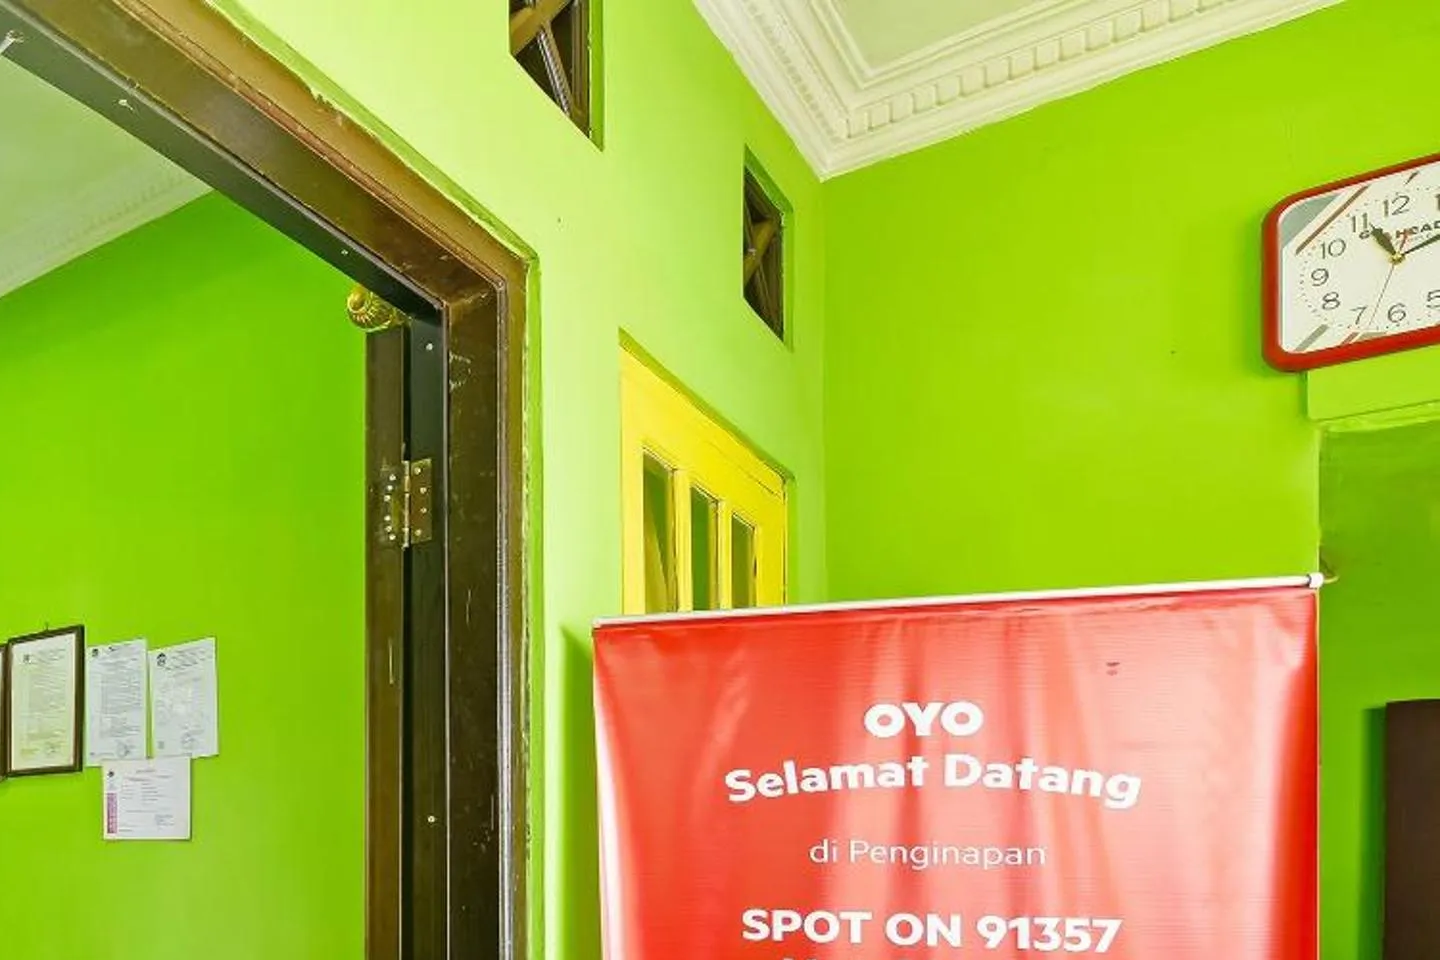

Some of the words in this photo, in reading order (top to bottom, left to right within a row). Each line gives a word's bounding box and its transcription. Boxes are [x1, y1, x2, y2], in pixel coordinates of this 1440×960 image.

[1384, 195, 1410, 217] 12
[1352, 213, 1368, 233] 11
[1321, 238, 1347, 259] 10
[1311, 268, 1329, 287] 9
[1322, 292, 1340, 310] 8
[1350, 306, 1367, 325] 7
[1387, 303, 1406, 323] 6
[864, 701, 984, 738] OYO
[725, 755, 928, 802] Selamat
[943, 753, 1142, 809] Datang
[809, 839, 839, 864] di
[849, 839, 1048, 870] Penginapan
[742, 909, 871, 944] SPOT
[885, 912, 961, 948] ON
[976, 914, 1123, 953] 91357
